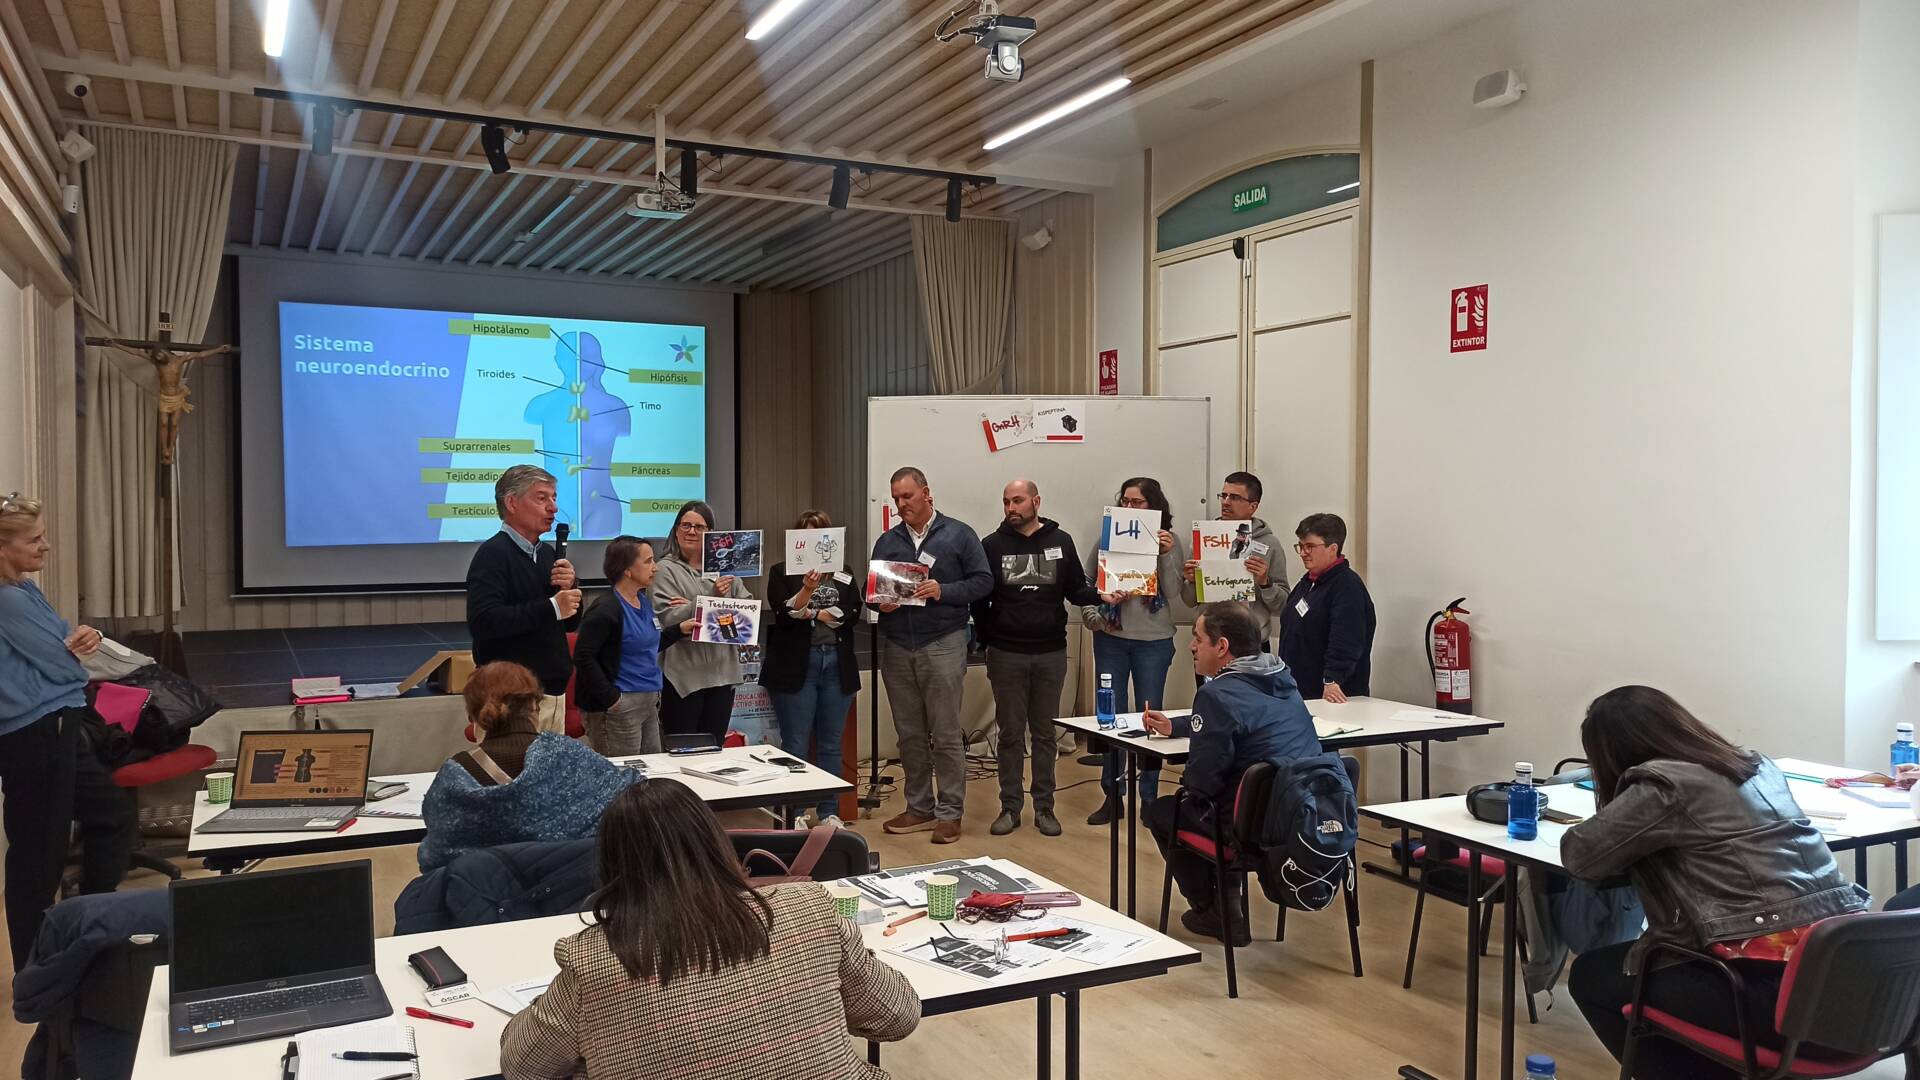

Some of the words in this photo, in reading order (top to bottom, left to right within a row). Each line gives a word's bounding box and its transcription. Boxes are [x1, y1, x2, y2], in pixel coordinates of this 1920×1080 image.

[1234, 186, 1266, 208] SALIDA
[472, 323, 530, 336] Hipotálamo
[294, 334, 374, 353] Sistema
[1452, 336, 1486, 348] EXTINTOR
[295, 359, 450, 378] neuroendocrino
[477, 368, 516, 379] Tiroides
[650, 372, 688, 383] Hipófisis
[640, 401, 662, 410] Timo
[443, 441, 511, 452] Suprarrenales
[631, 466, 671, 475] Páncreas
[446, 471, 475, 482] Tejido
[1115, 519, 1141, 540] LH
[795, 540, 806, 550] LH
[1203, 533, 1231, 550] FSH
